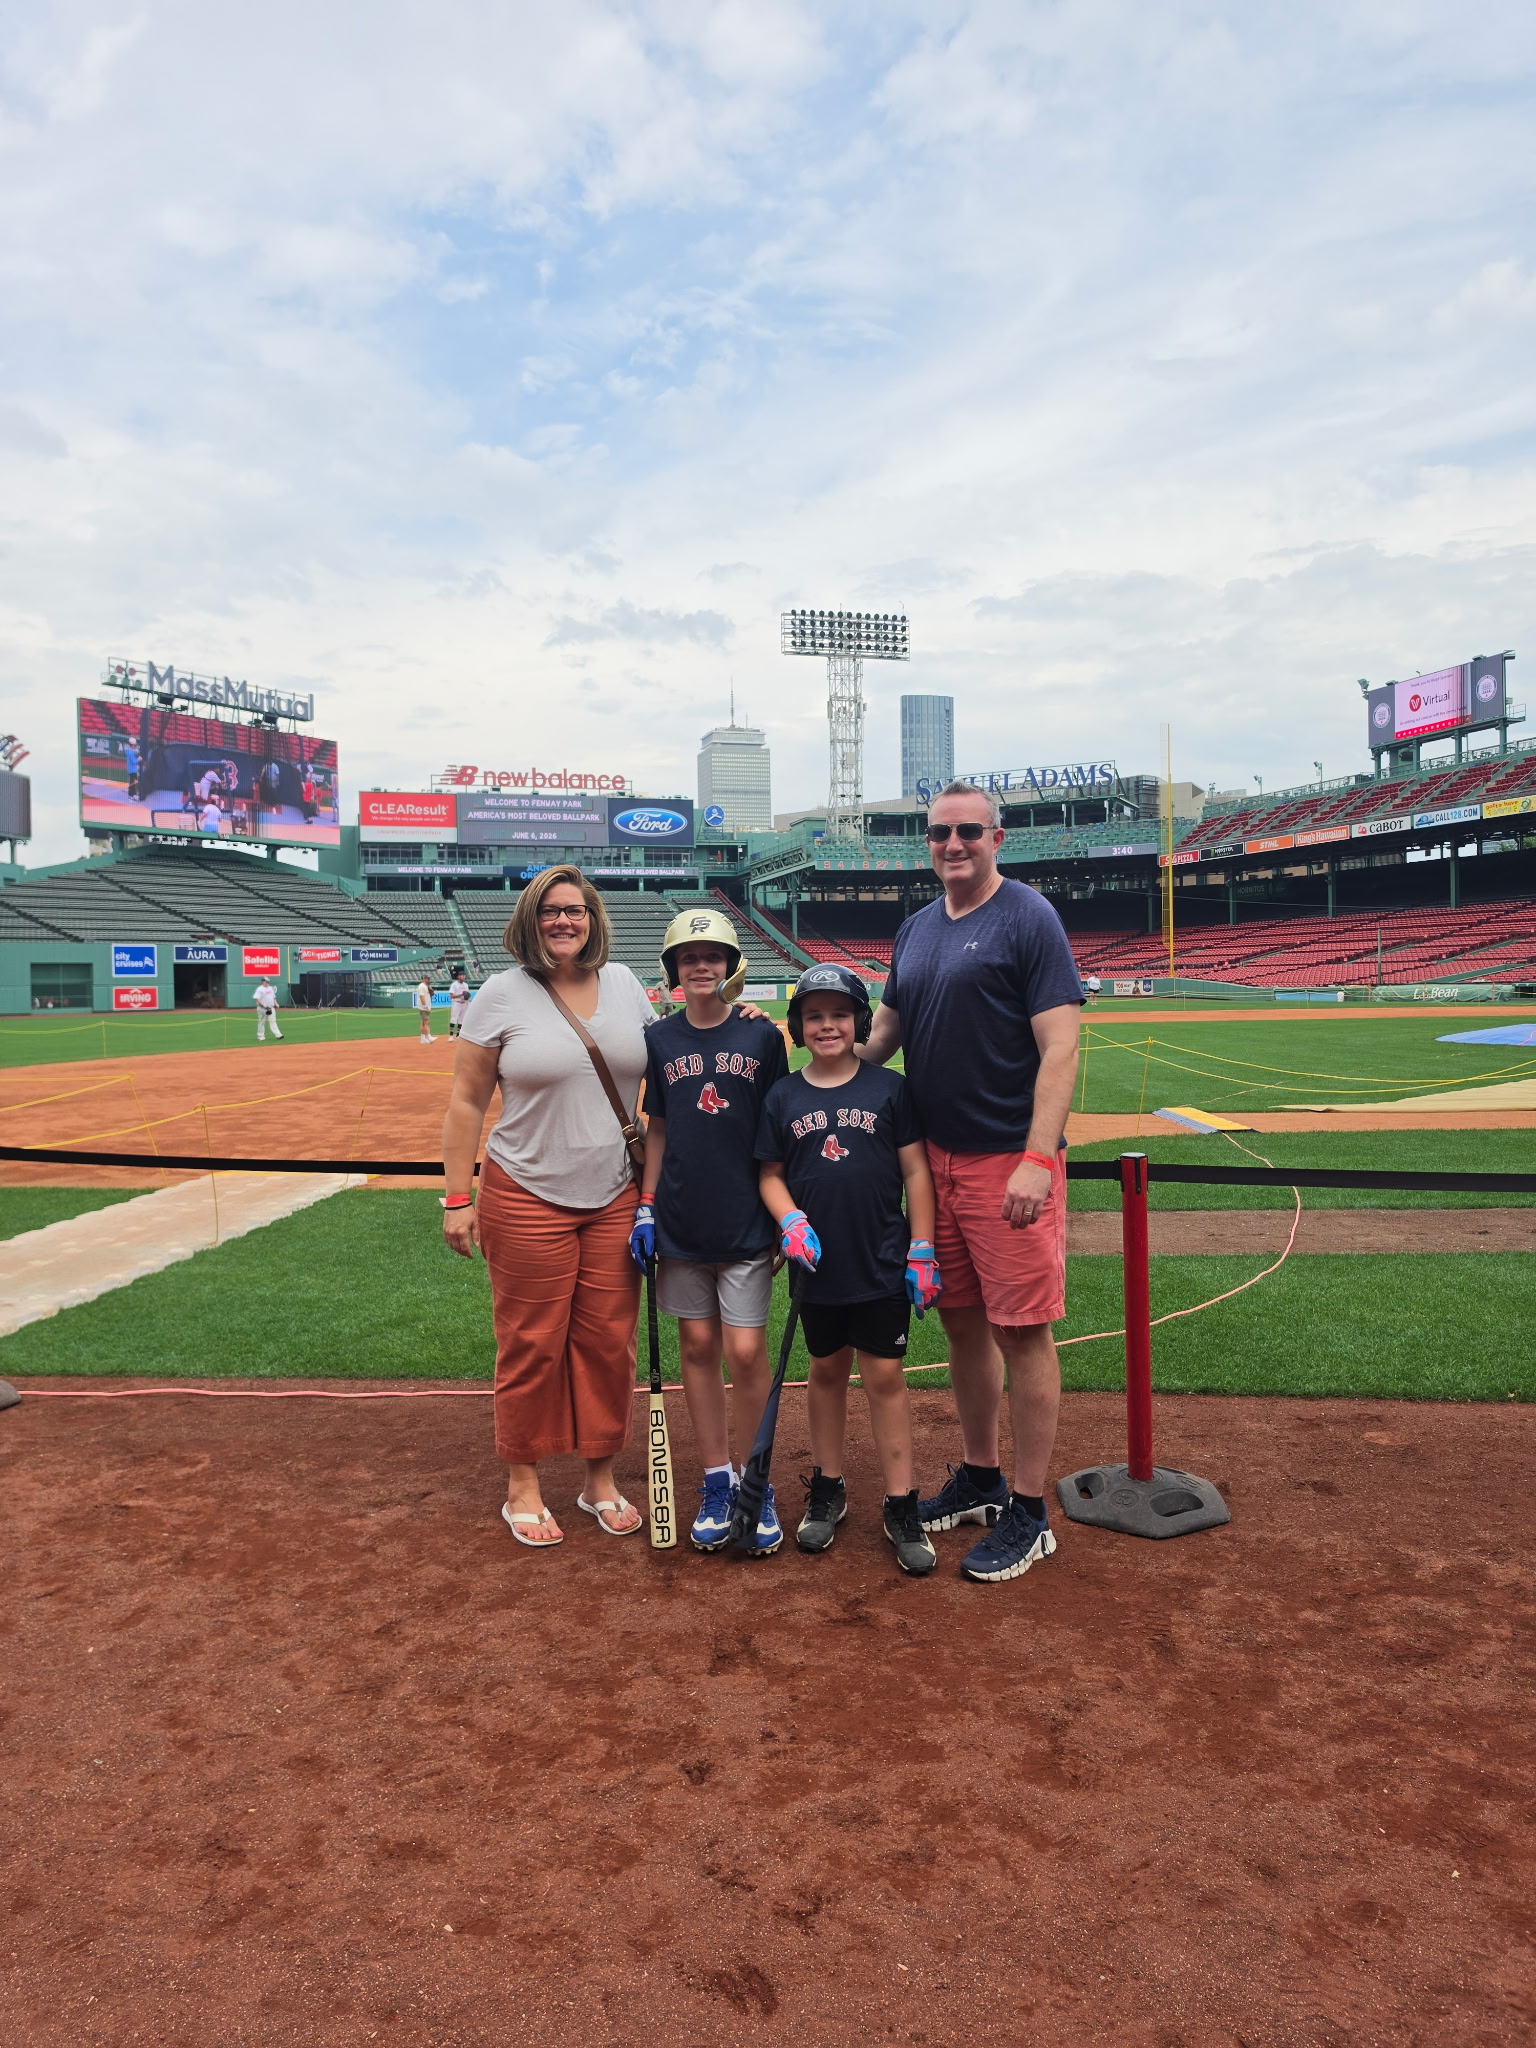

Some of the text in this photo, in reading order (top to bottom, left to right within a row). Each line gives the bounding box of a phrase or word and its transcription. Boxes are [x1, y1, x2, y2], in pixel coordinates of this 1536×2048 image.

[147, 661, 314, 721] MassMutual
[1422, 690, 1451, 706] Virtual
[483, 771, 529, 787] new
[532, 767, 626, 790] balance
[1022, 763, 1114, 791] ADAMS
[369, 802, 447, 815] CLEAResult
[484, 798, 582, 808] WELCOME TO FENWAY PARK
[467, 811, 600, 821] AMERICA'S MOST BELOVED BALLPARK
[1435, 807, 1478, 823] CALL128.COM
[628, 812, 673, 831] Ford
[512, 832, 557, 840] JUNE 6, 2026
[1297, 827, 1347, 845] King's Hawaiian
[1259, 839, 1279, 849] STIHL
[1111, 846, 1133, 855] 3:40
[1178, 853, 1194, 863] PIZZA
[837, 861, 844, 869] 4
[876, 861, 888, 869] 27
[914, 860, 925, 869] 14
[115, 952, 130, 961] city
[316, 950, 340, 960] TICKET
[120, 993, 152, 1003] IRVING
[663, 1053, 760, 1085] RED SOX
[791, 1108, 878, 1139] RED SOX
